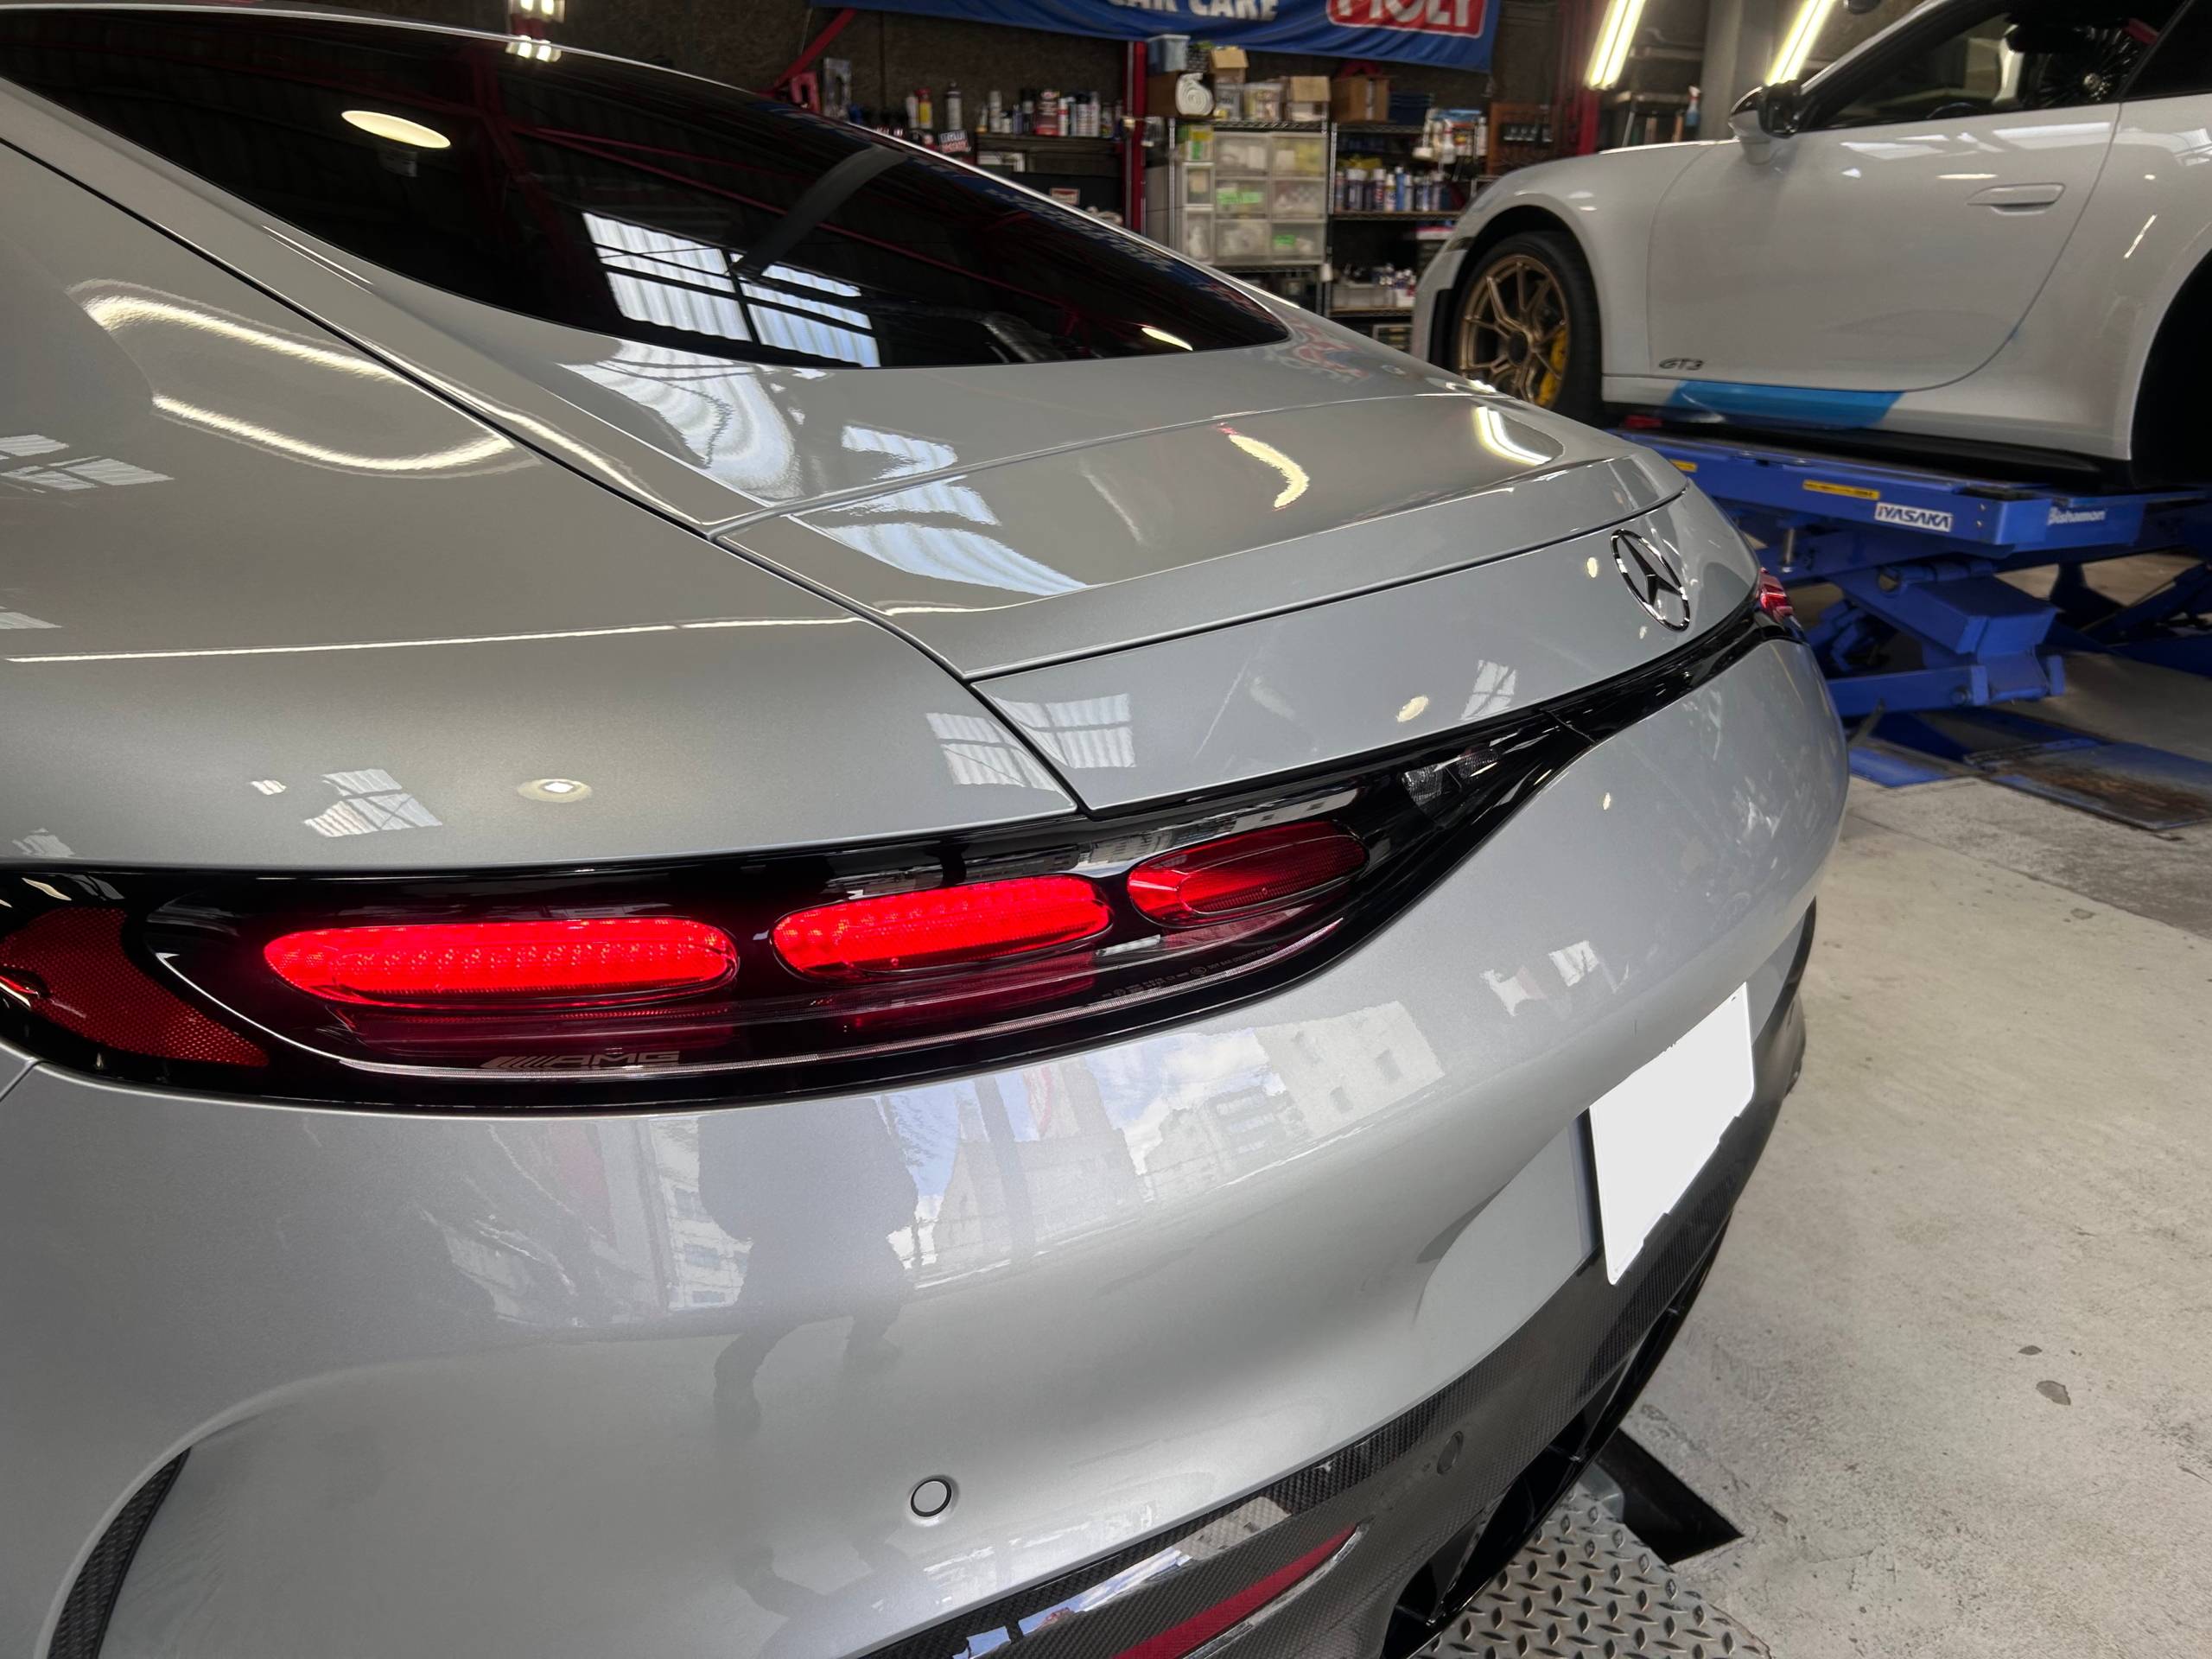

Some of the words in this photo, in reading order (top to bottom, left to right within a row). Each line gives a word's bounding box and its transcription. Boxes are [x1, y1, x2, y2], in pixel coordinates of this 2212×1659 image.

[1658, 357, 1704, 371] GT3
[1877, 505, 1952, 530] IYASAKA
[541, 1051, 680, 1068] AMG
